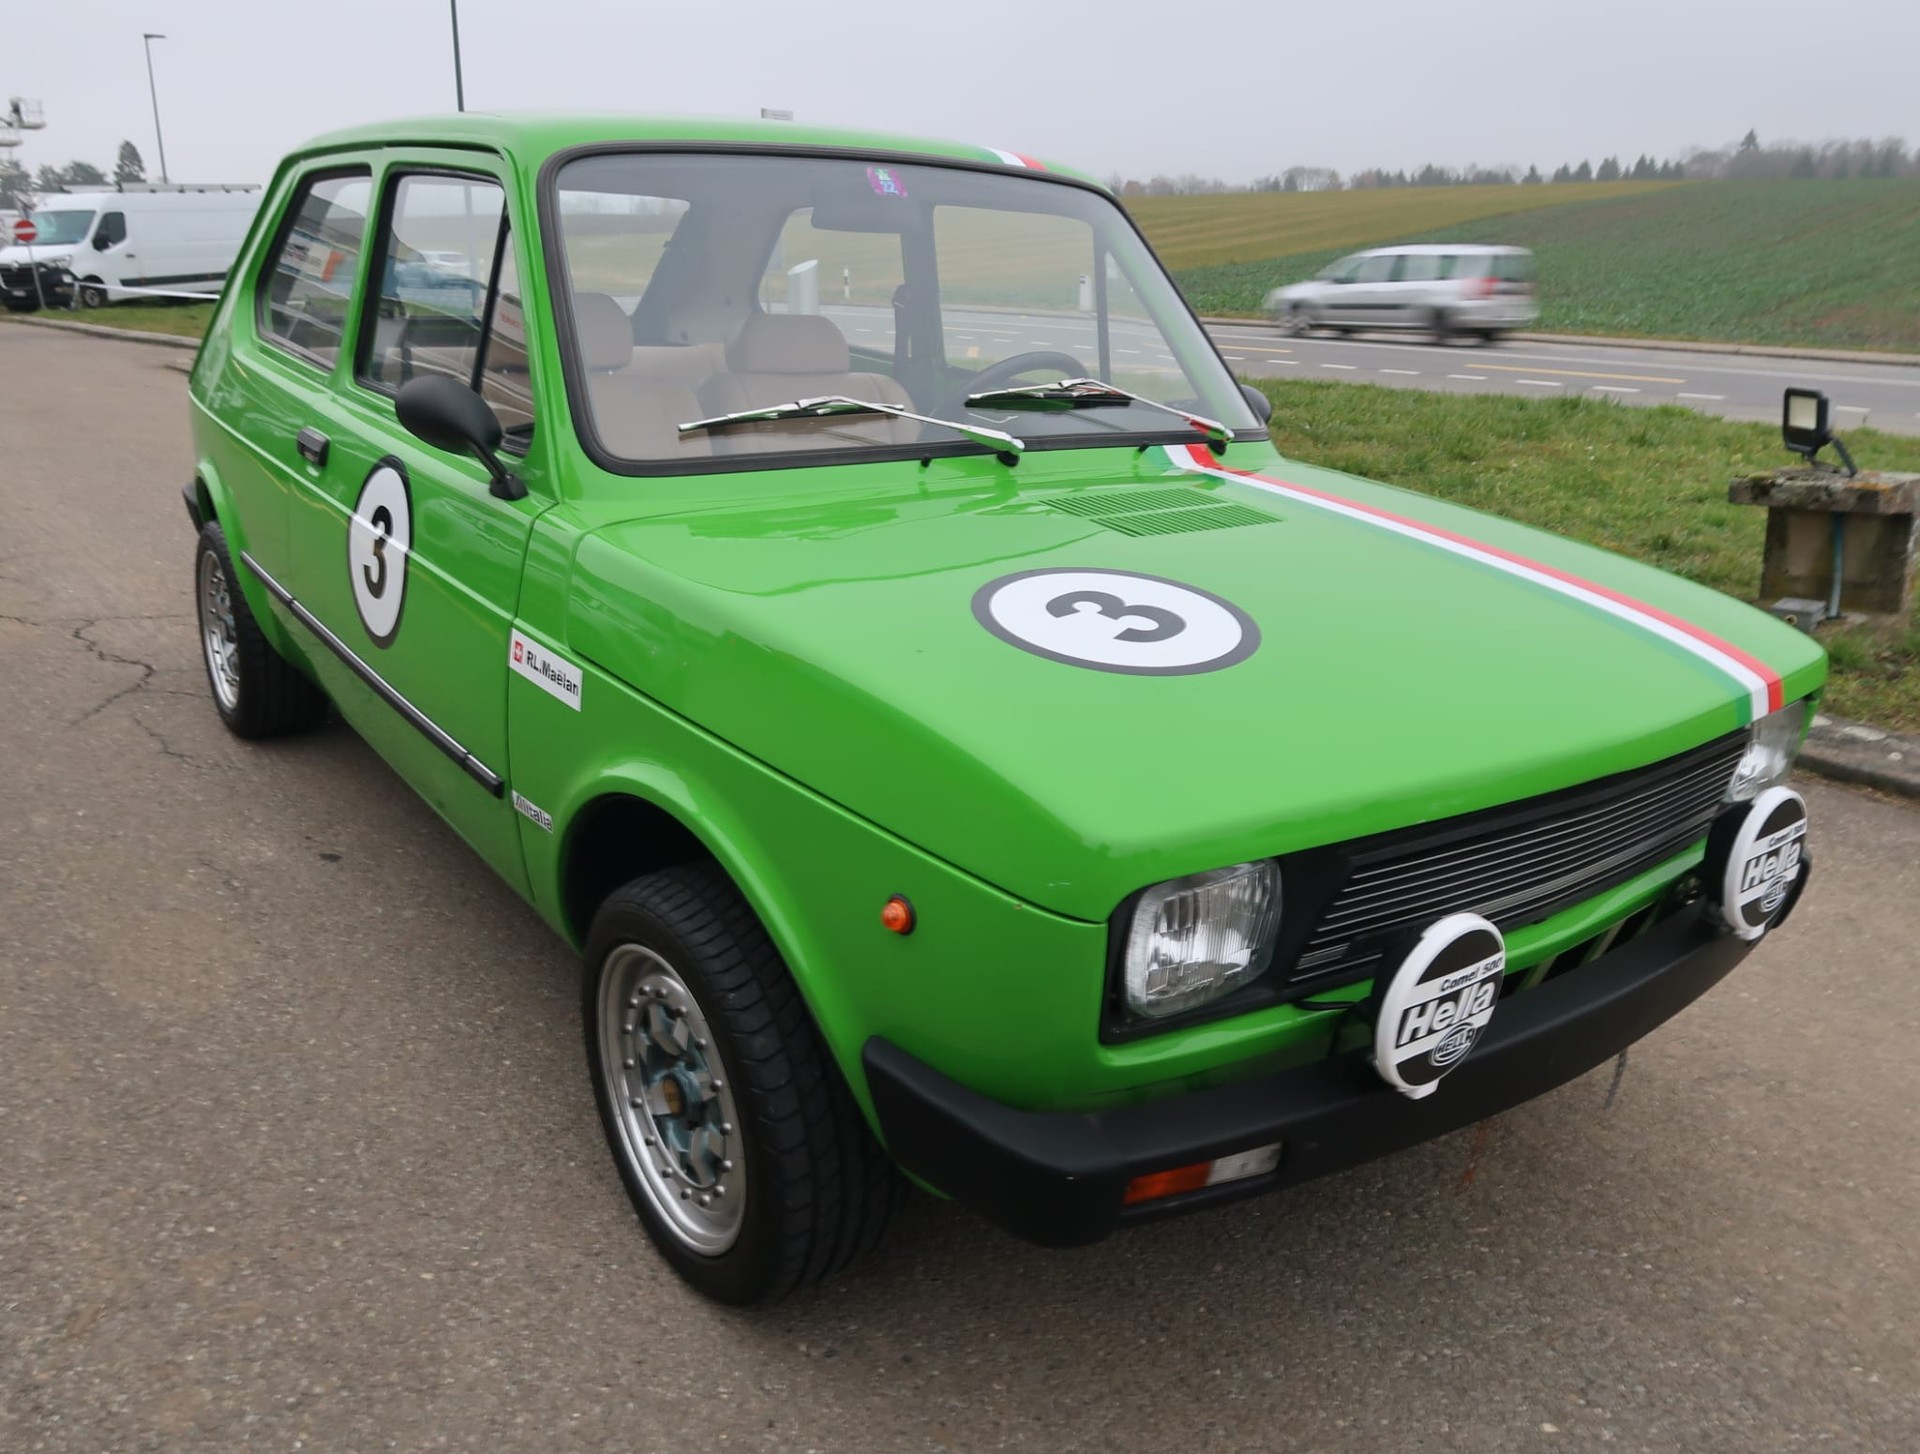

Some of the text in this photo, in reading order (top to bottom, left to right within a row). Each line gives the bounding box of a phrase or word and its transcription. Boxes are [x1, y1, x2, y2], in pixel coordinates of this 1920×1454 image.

[363, 505, 394, 600] 3
[1045, 590, 1188, 643] 3
[1741, 841, 1801, 891] Hella
[1398, 981, 1497, 1046] Hella
[1436, 1027, 1476, 1053] HELLA
